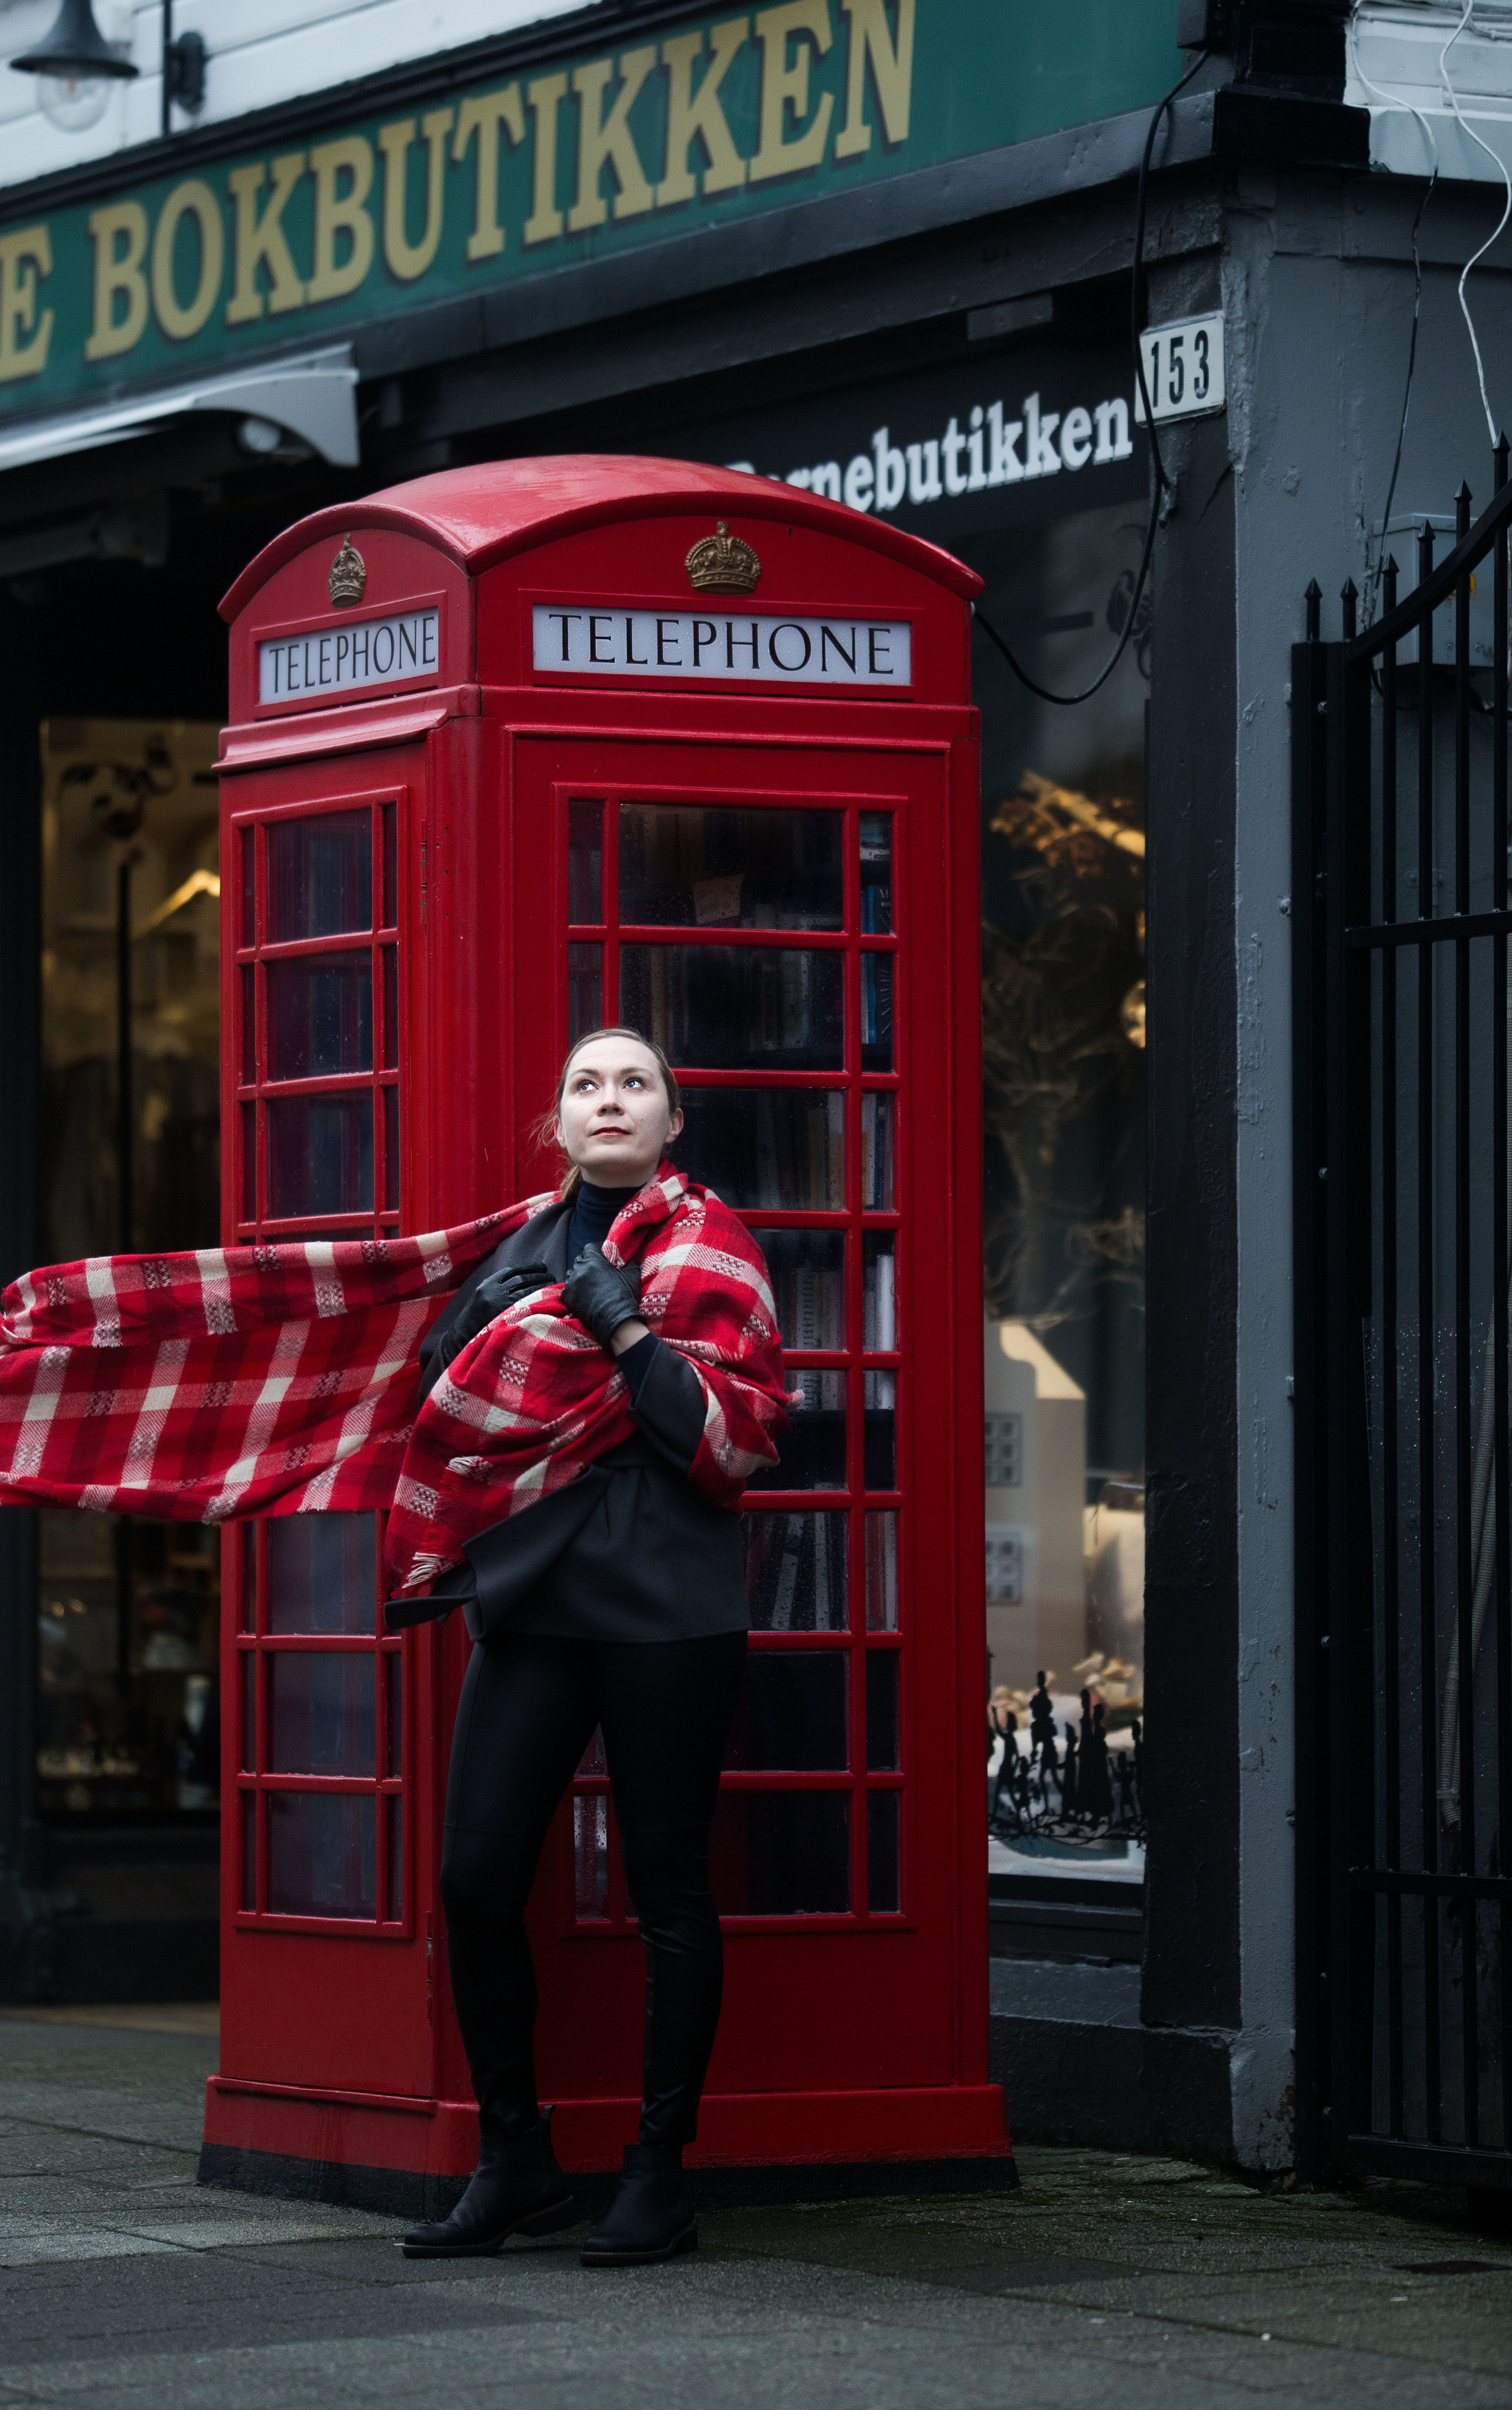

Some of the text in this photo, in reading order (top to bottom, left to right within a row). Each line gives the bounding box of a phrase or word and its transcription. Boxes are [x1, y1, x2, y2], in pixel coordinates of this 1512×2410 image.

[84, 0, 915, 361] BOKBUTIKKEN
[1151, 330, 1209, 408] 153
[724, 392, 1133, 513] nebutikken
[269, 616, 436, 693] TELEPHONE
[549, 614, 894, 675] TELEPHONE
